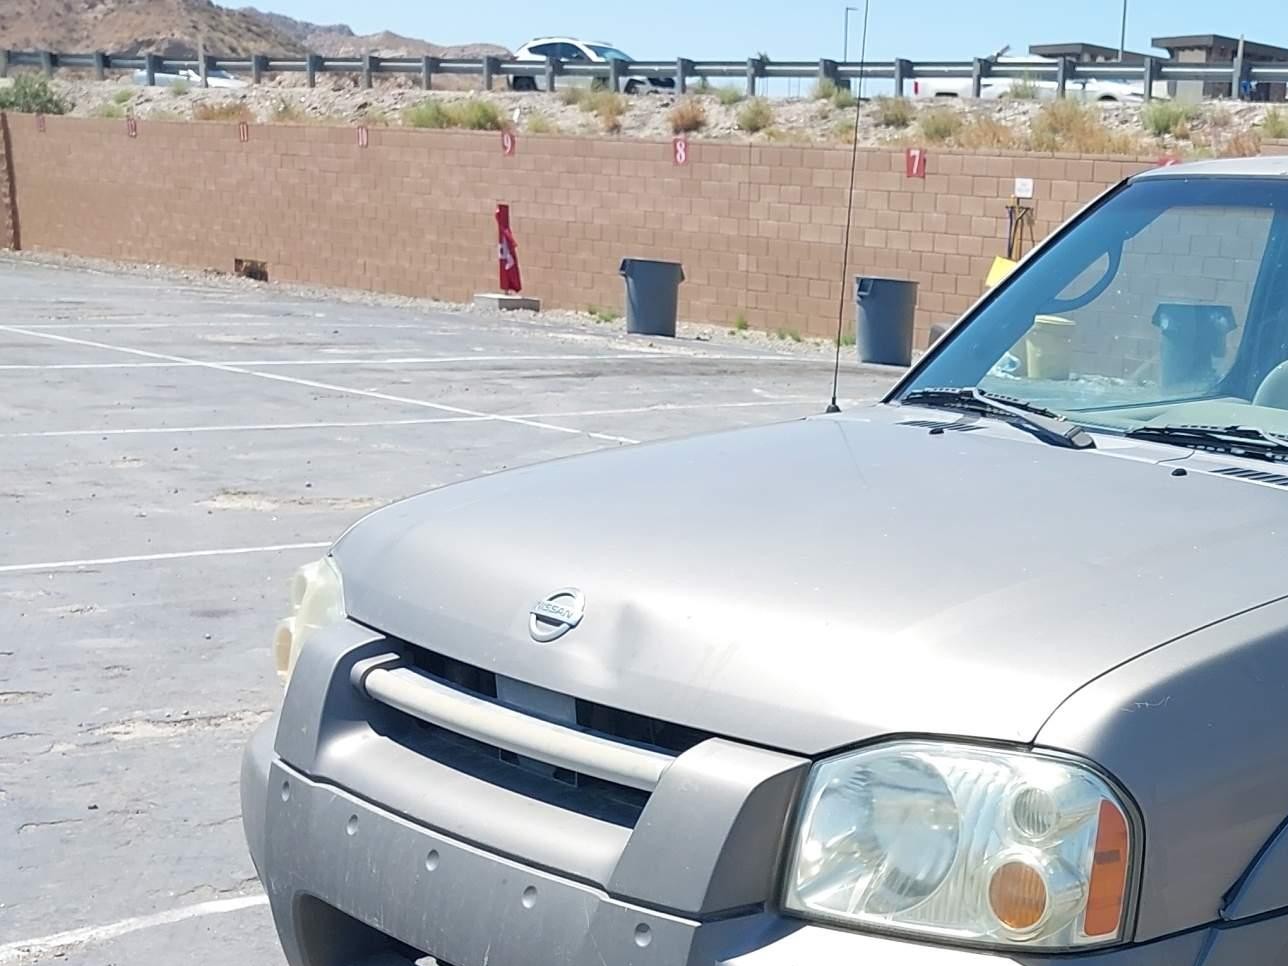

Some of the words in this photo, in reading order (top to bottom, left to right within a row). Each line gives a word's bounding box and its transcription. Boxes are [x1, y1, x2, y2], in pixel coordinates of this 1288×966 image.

[503, 133, 512, 154] 9
[675, 140, 686, 164] 8
[909, 149, 921, 175] 7
